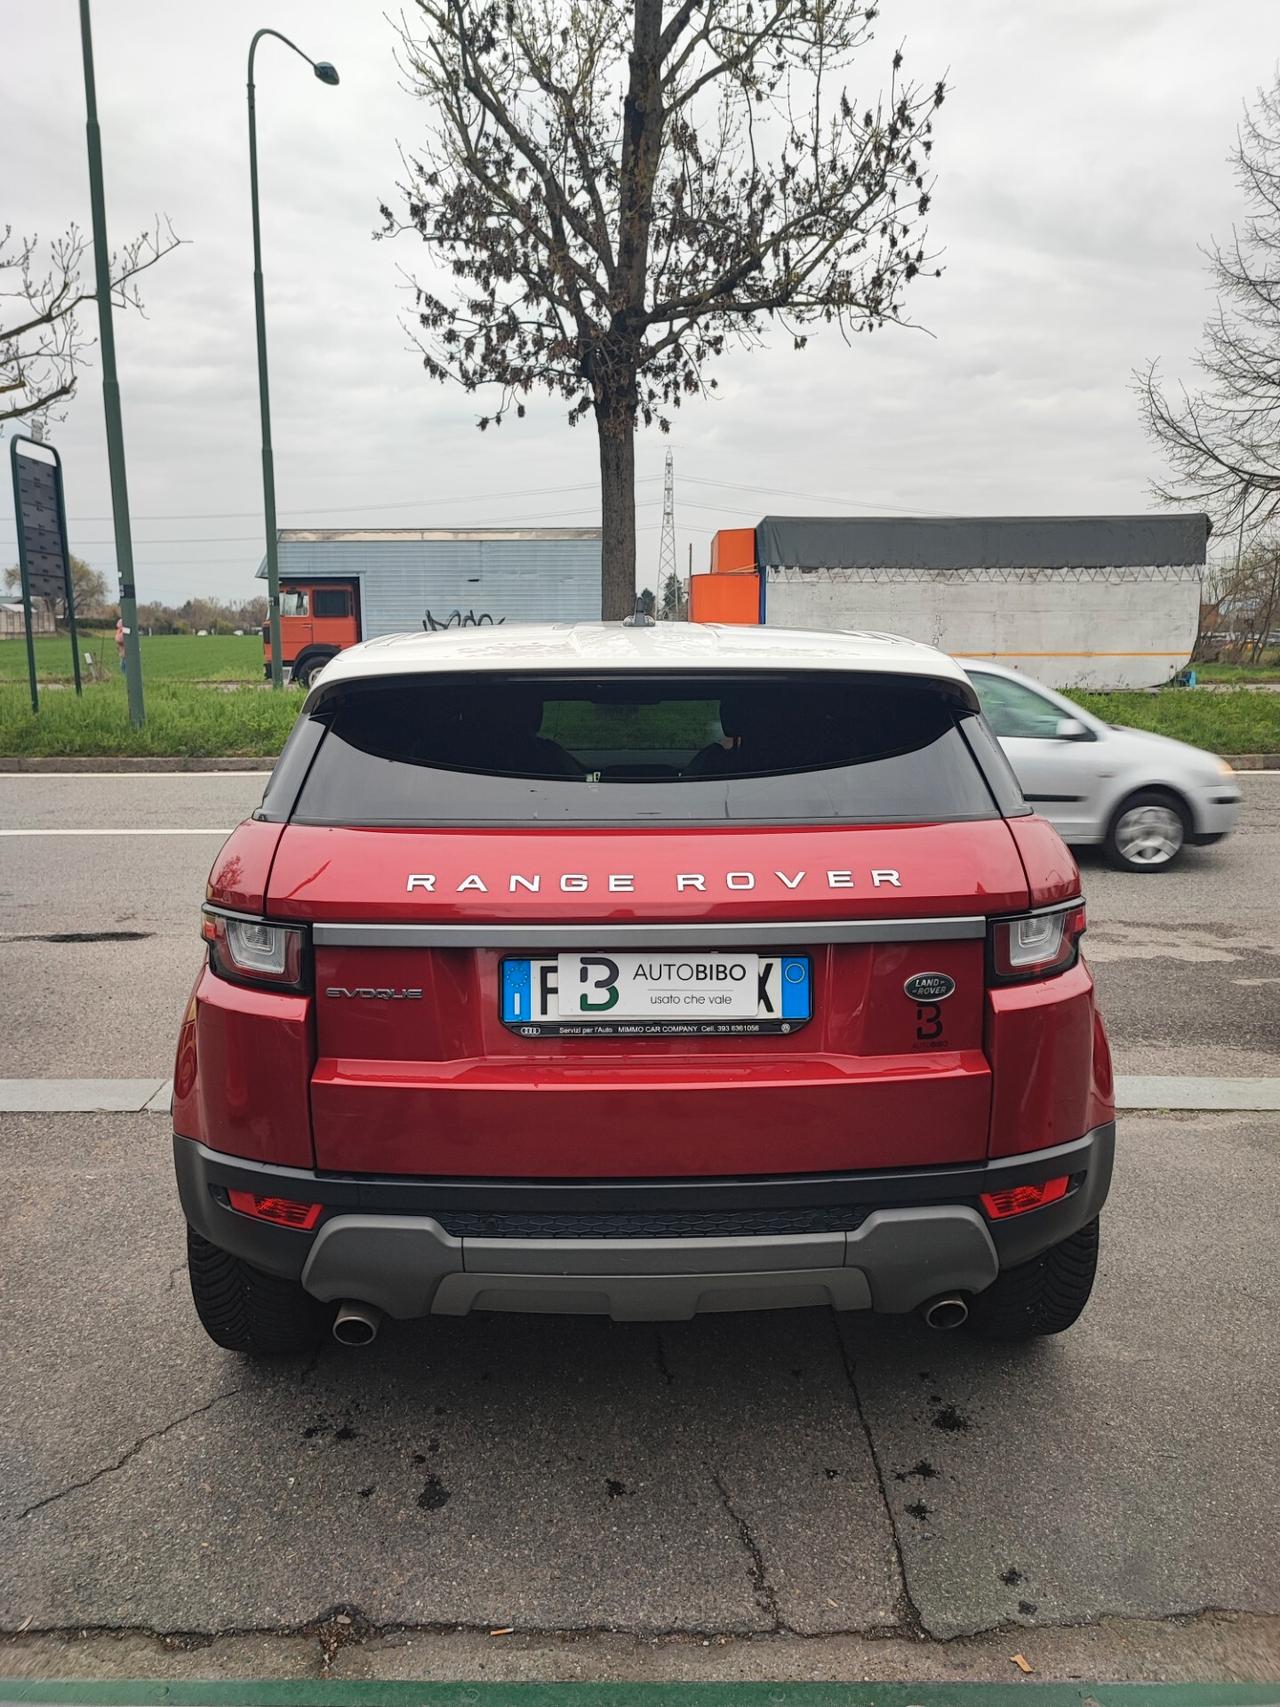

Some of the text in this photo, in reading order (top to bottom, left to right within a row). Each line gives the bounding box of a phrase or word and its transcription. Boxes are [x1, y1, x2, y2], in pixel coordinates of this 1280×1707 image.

[406, 869, 902, 893] RANGE ROVER
[632, 963, 747, 981] AUTOBIBO
[915, 978, 939, 988] LAND
[326, 987, 423, 1000] EVOQUE
[917, 986, 947, 995] ROVER
[650, 994, 733, 1005] usato che vale
[662, 1025, 699, 1033] COMPANY
